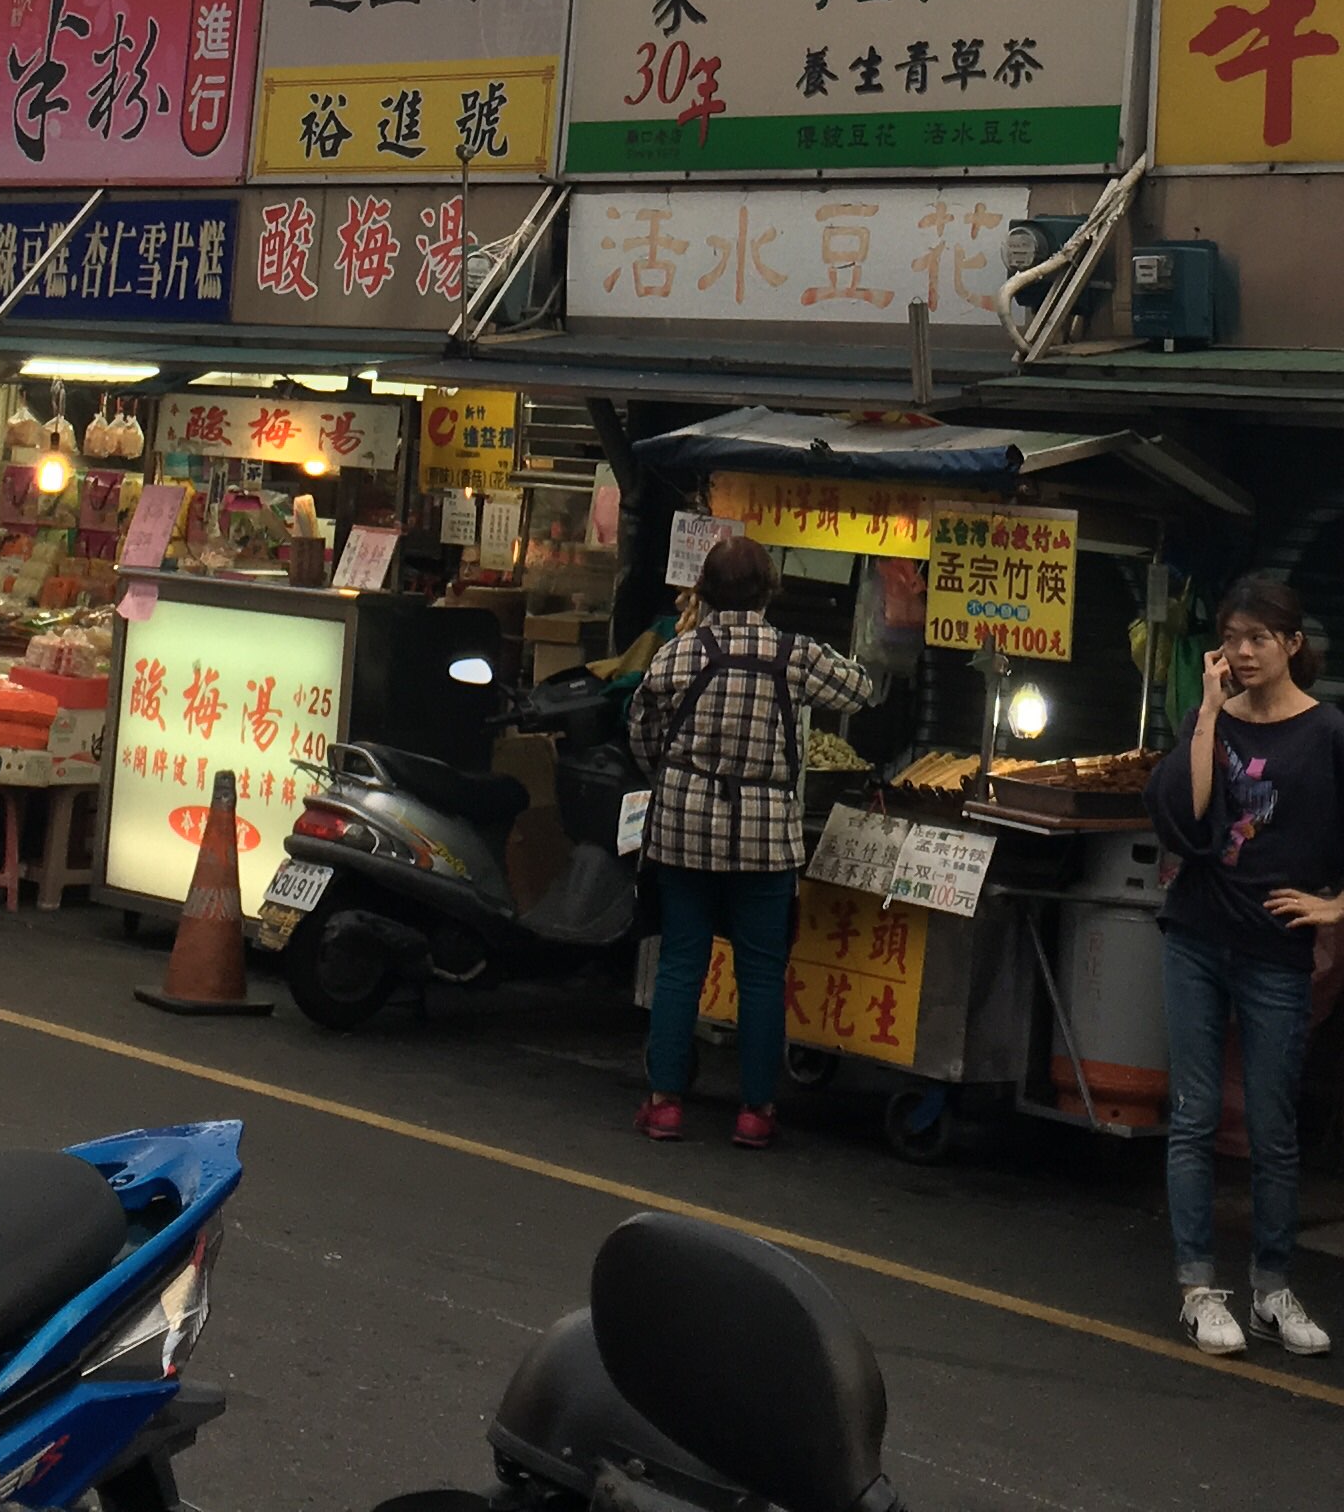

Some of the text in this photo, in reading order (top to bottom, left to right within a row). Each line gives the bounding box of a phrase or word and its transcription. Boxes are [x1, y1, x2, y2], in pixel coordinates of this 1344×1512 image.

[622, 40, 727, 148] 30年
[796, 38, 1045, 98] 養生青草茶
[300, 82, 508, 160] 裕進號
[923, 119, 1034, 146] 活水豆花
[257, 194, 478, 302] 酸梅湯
[601, 201, 1004, 313] 活水豆花
[185, 405, 365, 456] 酸梅湯
[934, 550, 1069, 606] 孟宗竹筷
[930, 617, 969, 644] 10雙
[130, 657, 284, 753] 酸梅湯
[914, 838, 989, 865] 孟宗竹筷
